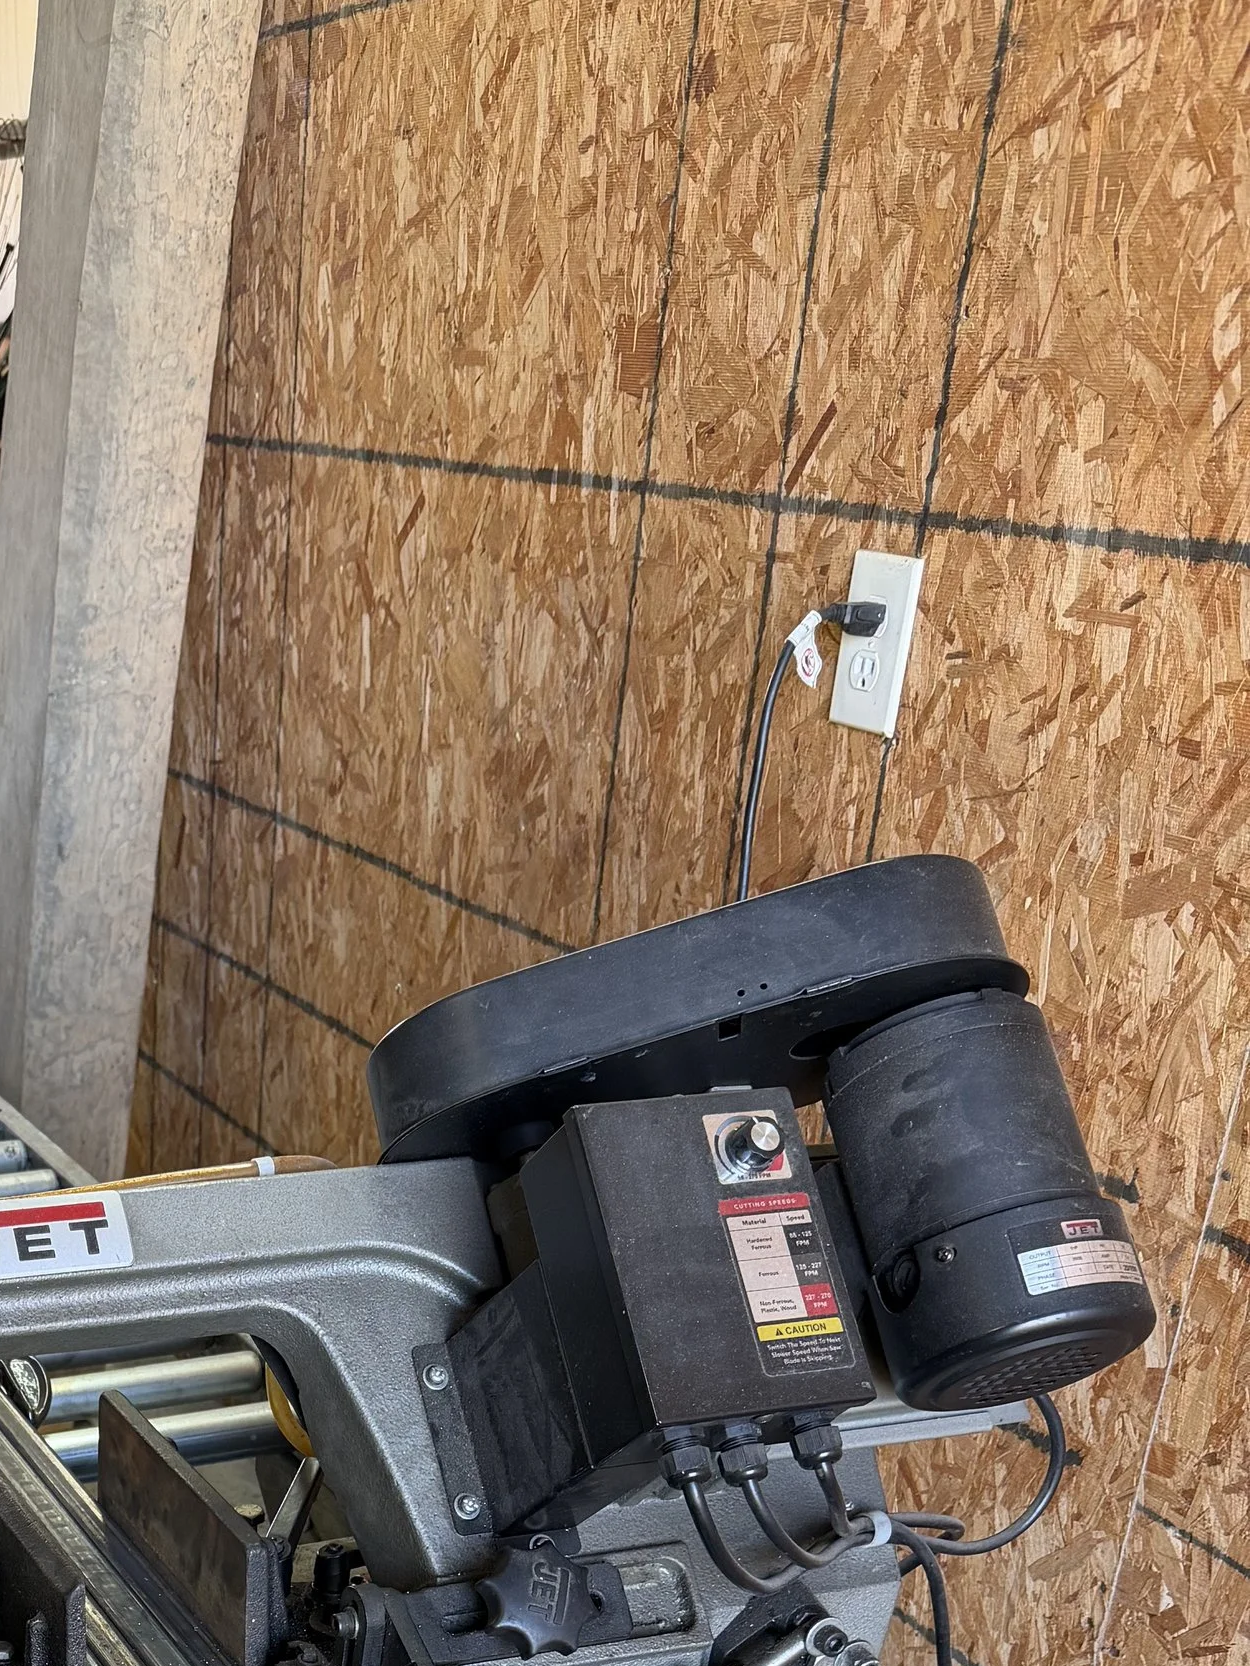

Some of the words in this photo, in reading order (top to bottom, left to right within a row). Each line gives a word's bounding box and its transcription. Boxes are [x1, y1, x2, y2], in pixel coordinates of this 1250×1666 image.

[733, 1201, 766, 1209] CUTTING
[767, 1198, 797, 1206] SPEEDS
[786, 1214, 805, 1222] Speed
[1068, 1225, 1099, 1236] JET
[758, 1269, 779, 1277] Ferrous
[784, 1322, 827, 1334] CAUTION
[799, 1339, 817, 1347] Speed
[771, 1350, 791, 1358] Slower
[792, 1347, 810, 1356] Speed
[527, 1561, 558, 1622] JET
